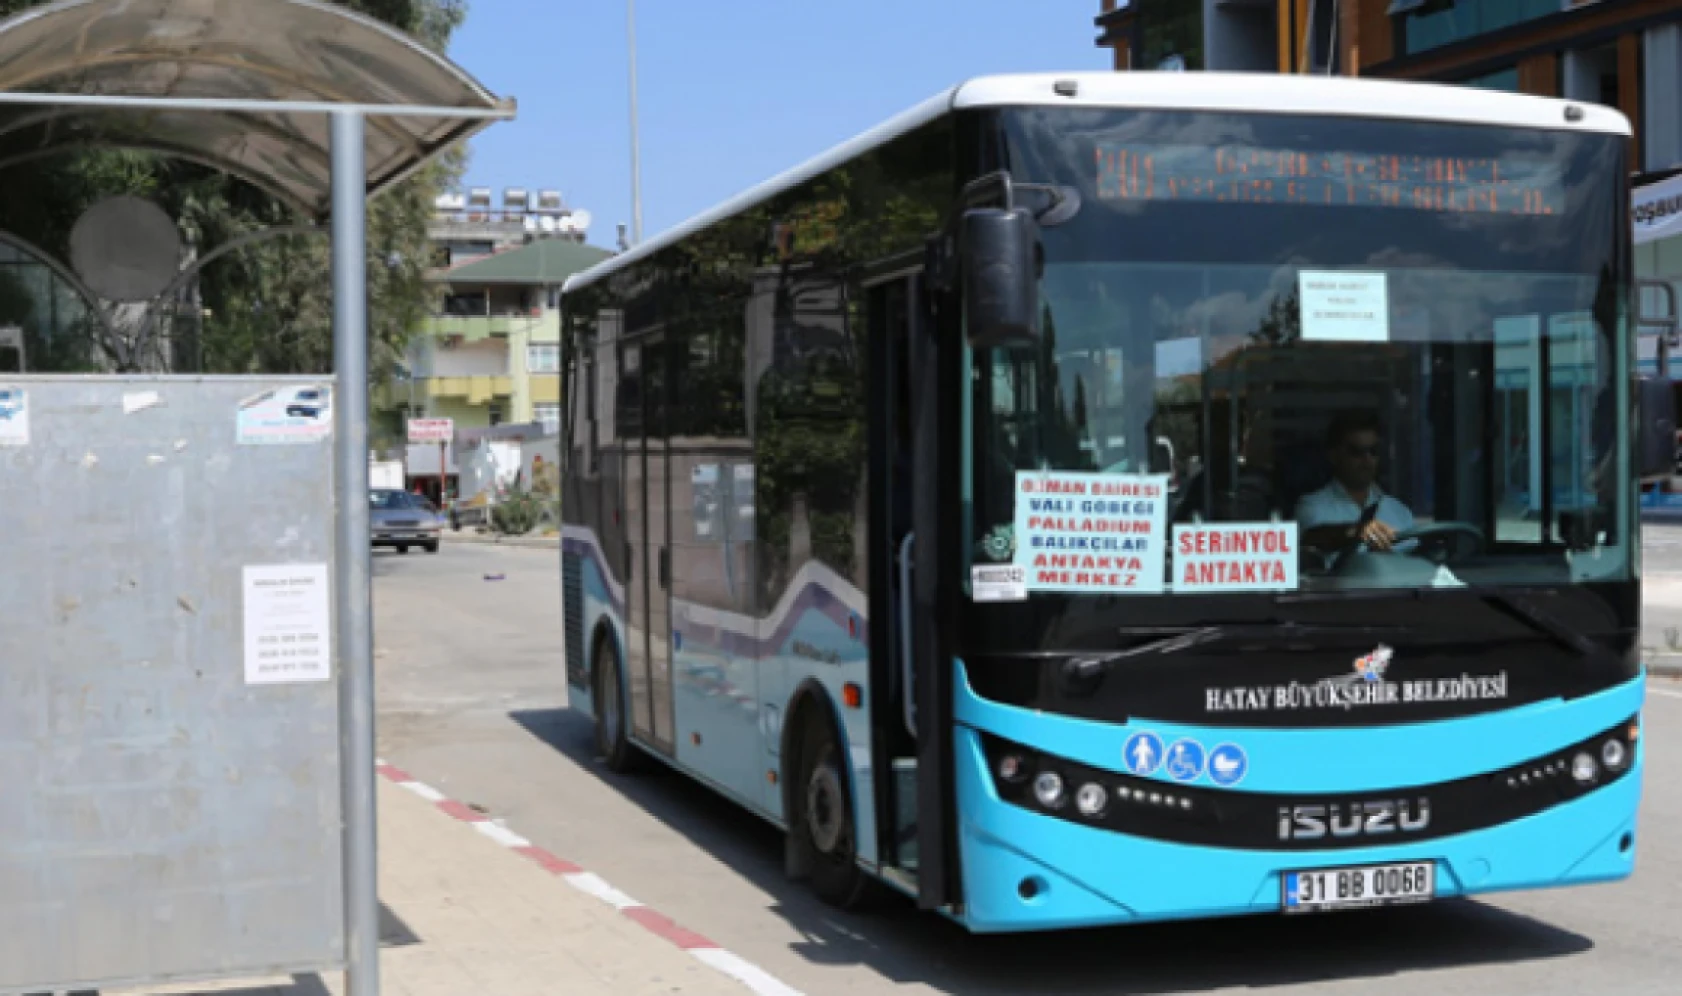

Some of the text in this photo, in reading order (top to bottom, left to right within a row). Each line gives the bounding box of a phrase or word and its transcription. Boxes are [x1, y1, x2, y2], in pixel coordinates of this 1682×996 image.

[1028, 515, 1151, 533] PALLADIUM
[1034, 553, 1142, 569] ANTAKYA
[1184, 560, 1286, 584] ANTAKYA
[1037, 570, 1136, 585] MERKEZ
[1205, 687, 1271, 711] HATAY
[1277, 797, 1430, 841] ISUZU
[1299, 873, 1325, 901] 31
[1337, 870, 1364, 898] BB
